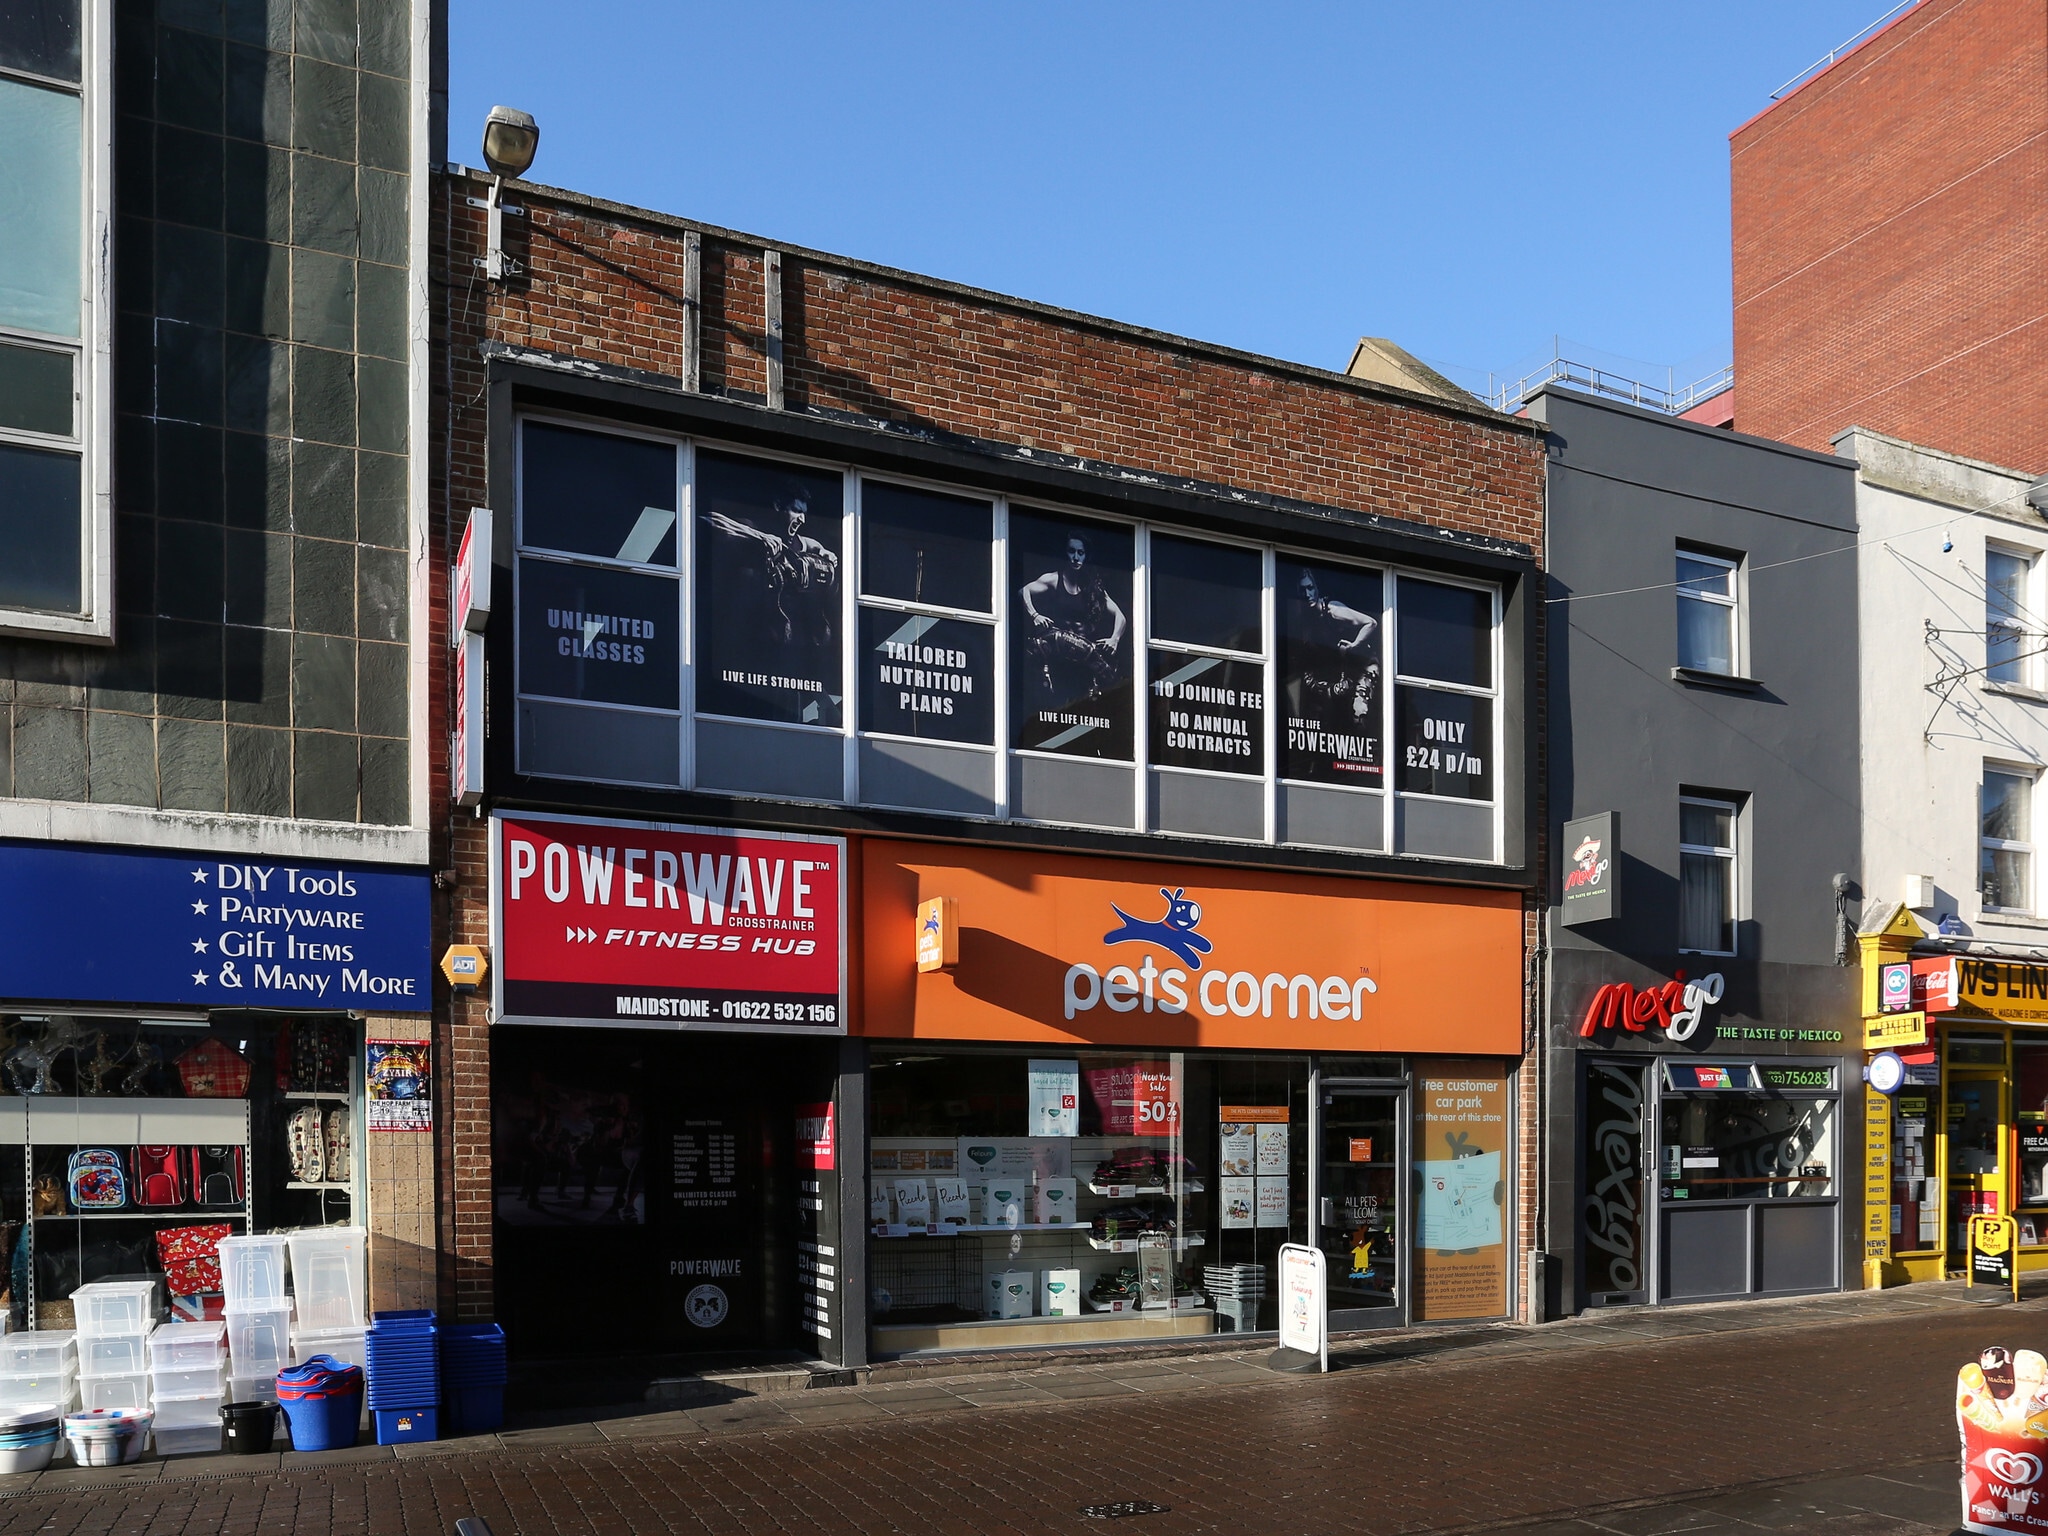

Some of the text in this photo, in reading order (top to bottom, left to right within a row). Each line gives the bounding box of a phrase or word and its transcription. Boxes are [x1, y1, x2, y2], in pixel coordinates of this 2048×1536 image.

[548, 608, 655, 640] UNLIMITED
[558, 636, 645, 665] CLASSES
[886, 641, 967, 669] TAILORED
[722, 670, 823, 693] LIVE LIFE STRONGER
[880, 665, 973, 694] NUTRITION
[900, 692, 954, 716] PLANS
[1155, 680, 1262, 709] NO JOINING FEE
[1039, 711, 1110, 729] LIVE LIFE LEANER
[1170, 711, 1248, 736] NO ANNUAL
[1288, 717, 1321, 730] LIVE LIFE
[1423, 718, 1466, 744] ONLY
[1167, 731, 1251, 756] CONTRACTS
[1288, 729, 1373, 760] POWERWAVE
[1406, 745, 1482, 775] £24 p/m
[218, 864, 357, 897] DIY Tools
[510, 839, 815, 926] POWERWAVE
[1565, 859, 1608, 891] Mexigo
[728, 916, 815, 931] CROSSTRAINER
[219, 931, 276, 958] Gift
[604, 928, 816, 956] FITNESS HUB
[919, 934, 933, 951] pets
[453, 960, 476, 970] ADT
[919, 947, 940, 964] corner
[218, 961, 243, 988] &
[342, 968, 416, 995] MORE
[1064, 955, 1378, 1022] pets corner
[616, 996, 836, 1023] MAIDSTONE 01622 532 156
[1580, 969, 1725, 1042] Mexigo
[1715, 1026, 1842, 1042] THE TASTE OF MEXICO
[1869, 1018, 1913, 1031] WESTERN
[1881, 1025, 1912, 1036] UNION
[382, 1069, 412, 1077] ZYAIR
[1142, 1071, 1175, 1082] New Year
[1699, 1074, 1728, 1082] JUST EAT
[1785, 1071, 1829, 1085] 756283
[1149, 1082, 1167, 1092] Sale
[1419, 1078, 1498, 1092] Free customer
[1064, 1098, 1073, 1106] £4
[1139, 1100, 1178, 1122] 50%
[1435, 1095, 1482, 1111] car park
[1425, 1112, 1438, 1121] the
[1440, 1113, 1456, 1121] rear
[1457, 1112, 1467, 1121] of
[1467, 1113, 1480, 1121] this
[1482, 1113, 1501, 1122] store
[2023, 1137, 2038, 1145] FREE
[674, 1190, 736, 1199] UNLIMITED CLASSES
[1345, 1196, 1378, 1207] ALL PETS
[1983, 1235, 1994, 1243] Pay
[1868, 1247, 1884, 1256] LINE
[670, 1259, 741, 1278] POWERWAVE
[1988, 1376, 2013, 1385] MAGNUM
[1988, 1483, 2039, 1505] WALL'S
[1972, 1504, 2048, 1527] Fancy an Ice Crea
